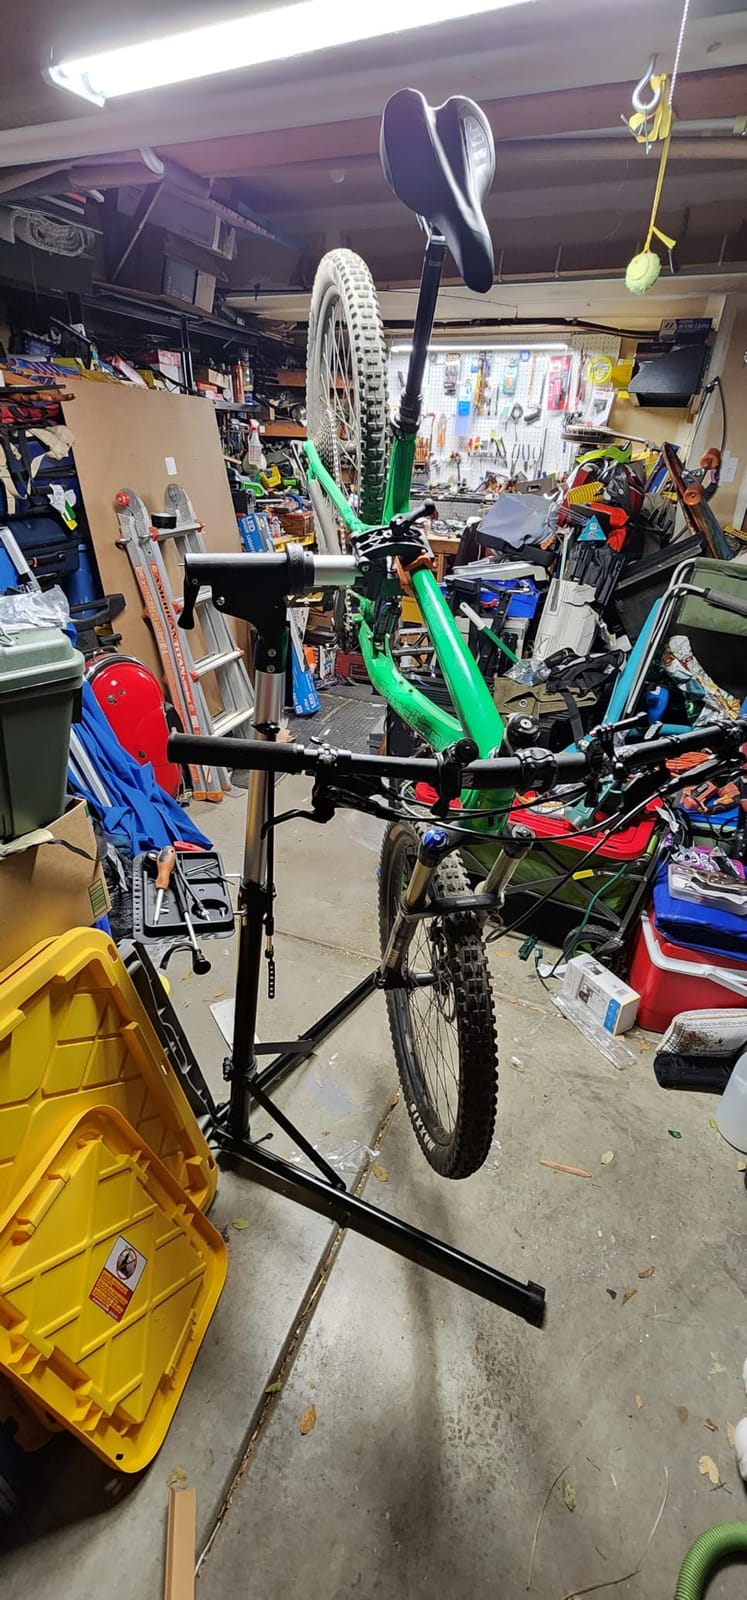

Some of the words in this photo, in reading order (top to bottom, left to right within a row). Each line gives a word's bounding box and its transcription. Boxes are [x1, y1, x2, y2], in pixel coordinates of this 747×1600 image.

[245, 516, 255, 532] LED
[154, 576, 178, 639] AMERICAN
[174, 640, 186, 676] TITAN
